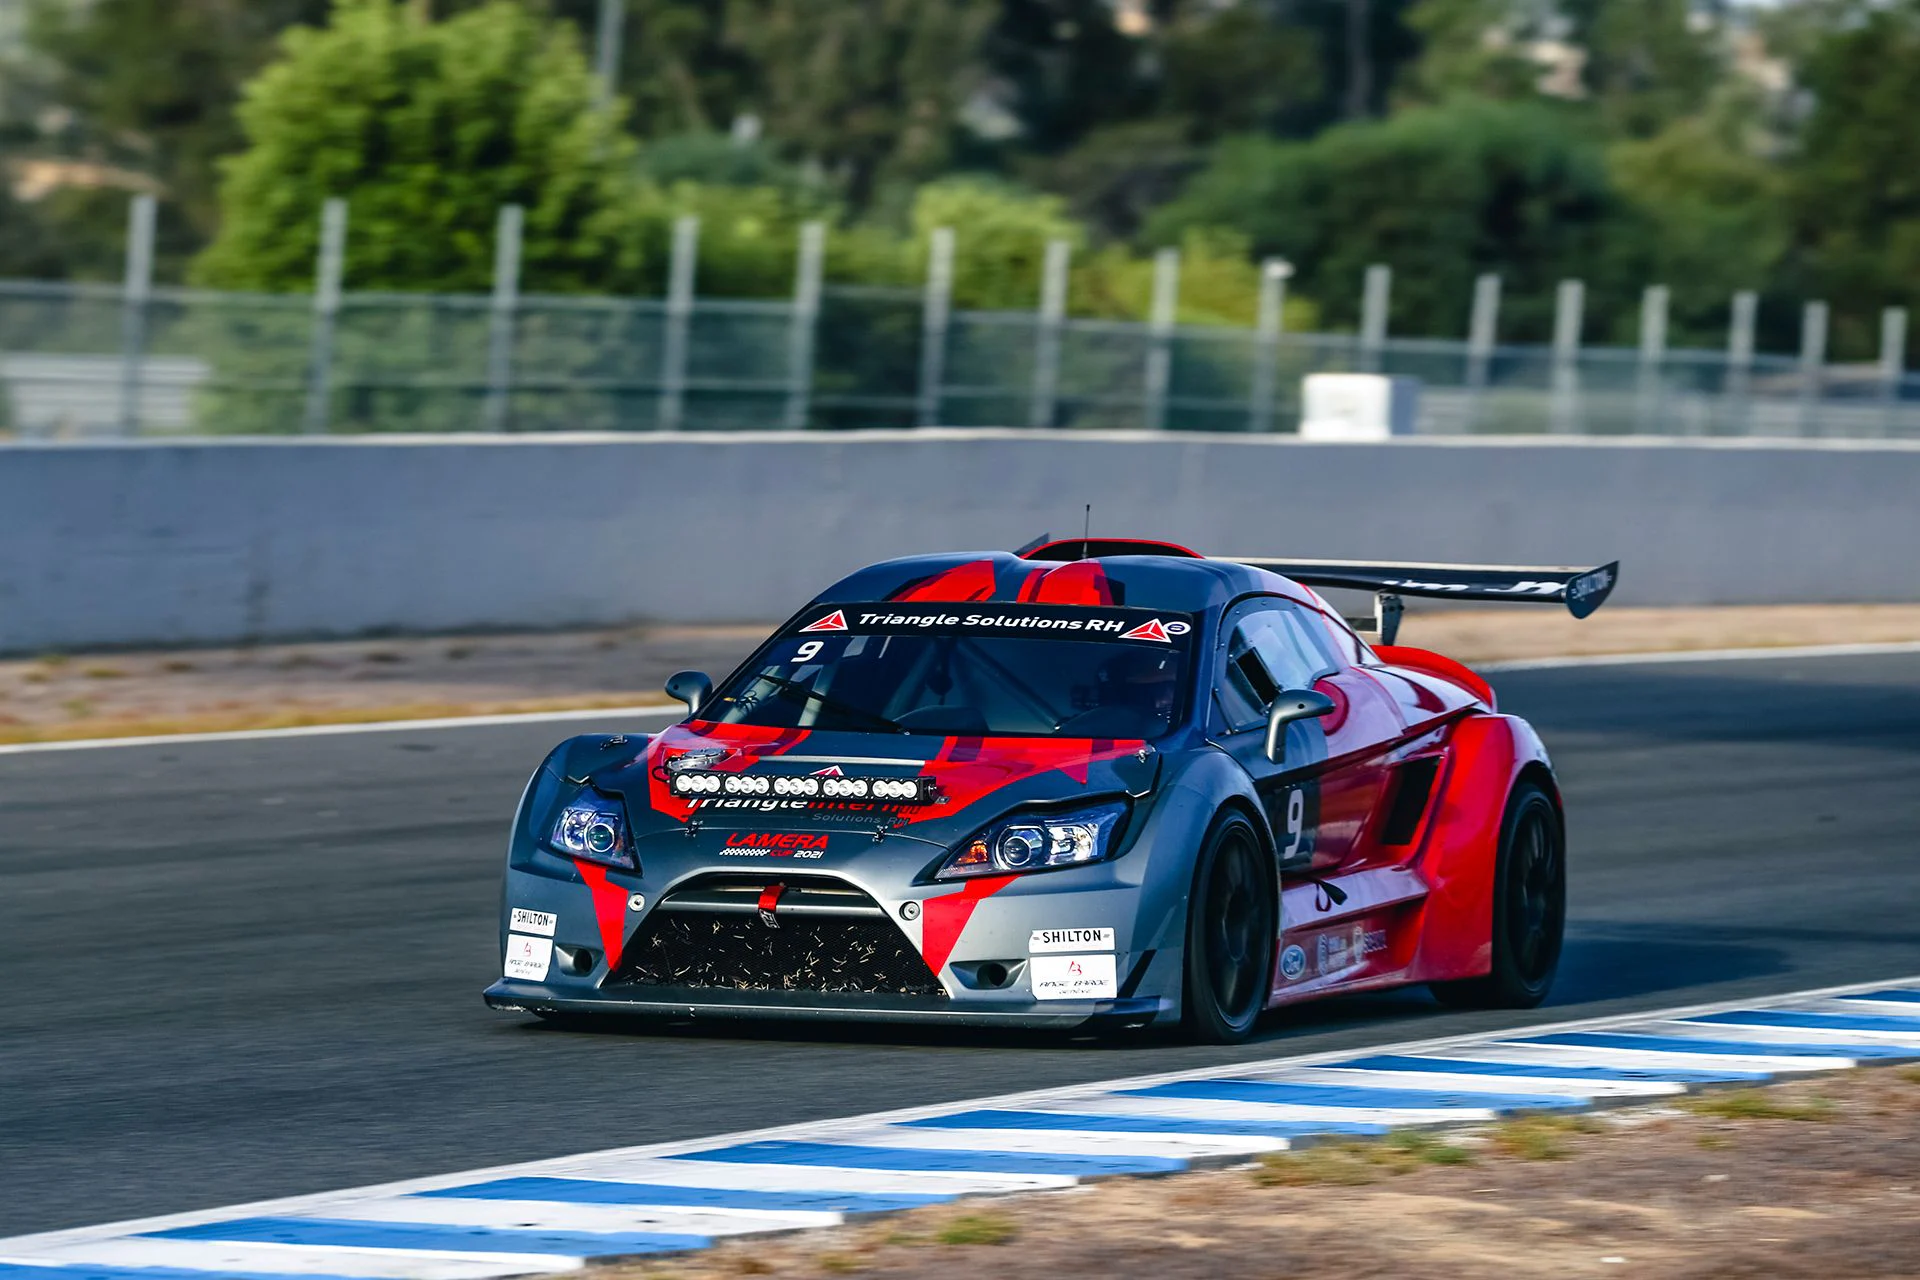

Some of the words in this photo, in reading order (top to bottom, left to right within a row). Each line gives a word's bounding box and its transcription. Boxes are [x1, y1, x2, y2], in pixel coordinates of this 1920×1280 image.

[859, 612, 958, 628] Triangle
[961, 614, 1083, 630] Solutions
[1085, 618, 1125, 632] RH
[791, 641, 825, 663] 9
[812, 812, 881, 824] Solutions
[1283, 788, 1304, 860] 9
[725, 832, 829, 849] LAMERA
[793, 850, 825, 859] 2021
[517, 910, 549, 926] SHILTON
[1042, 930, 1102, 943] SHILTON
